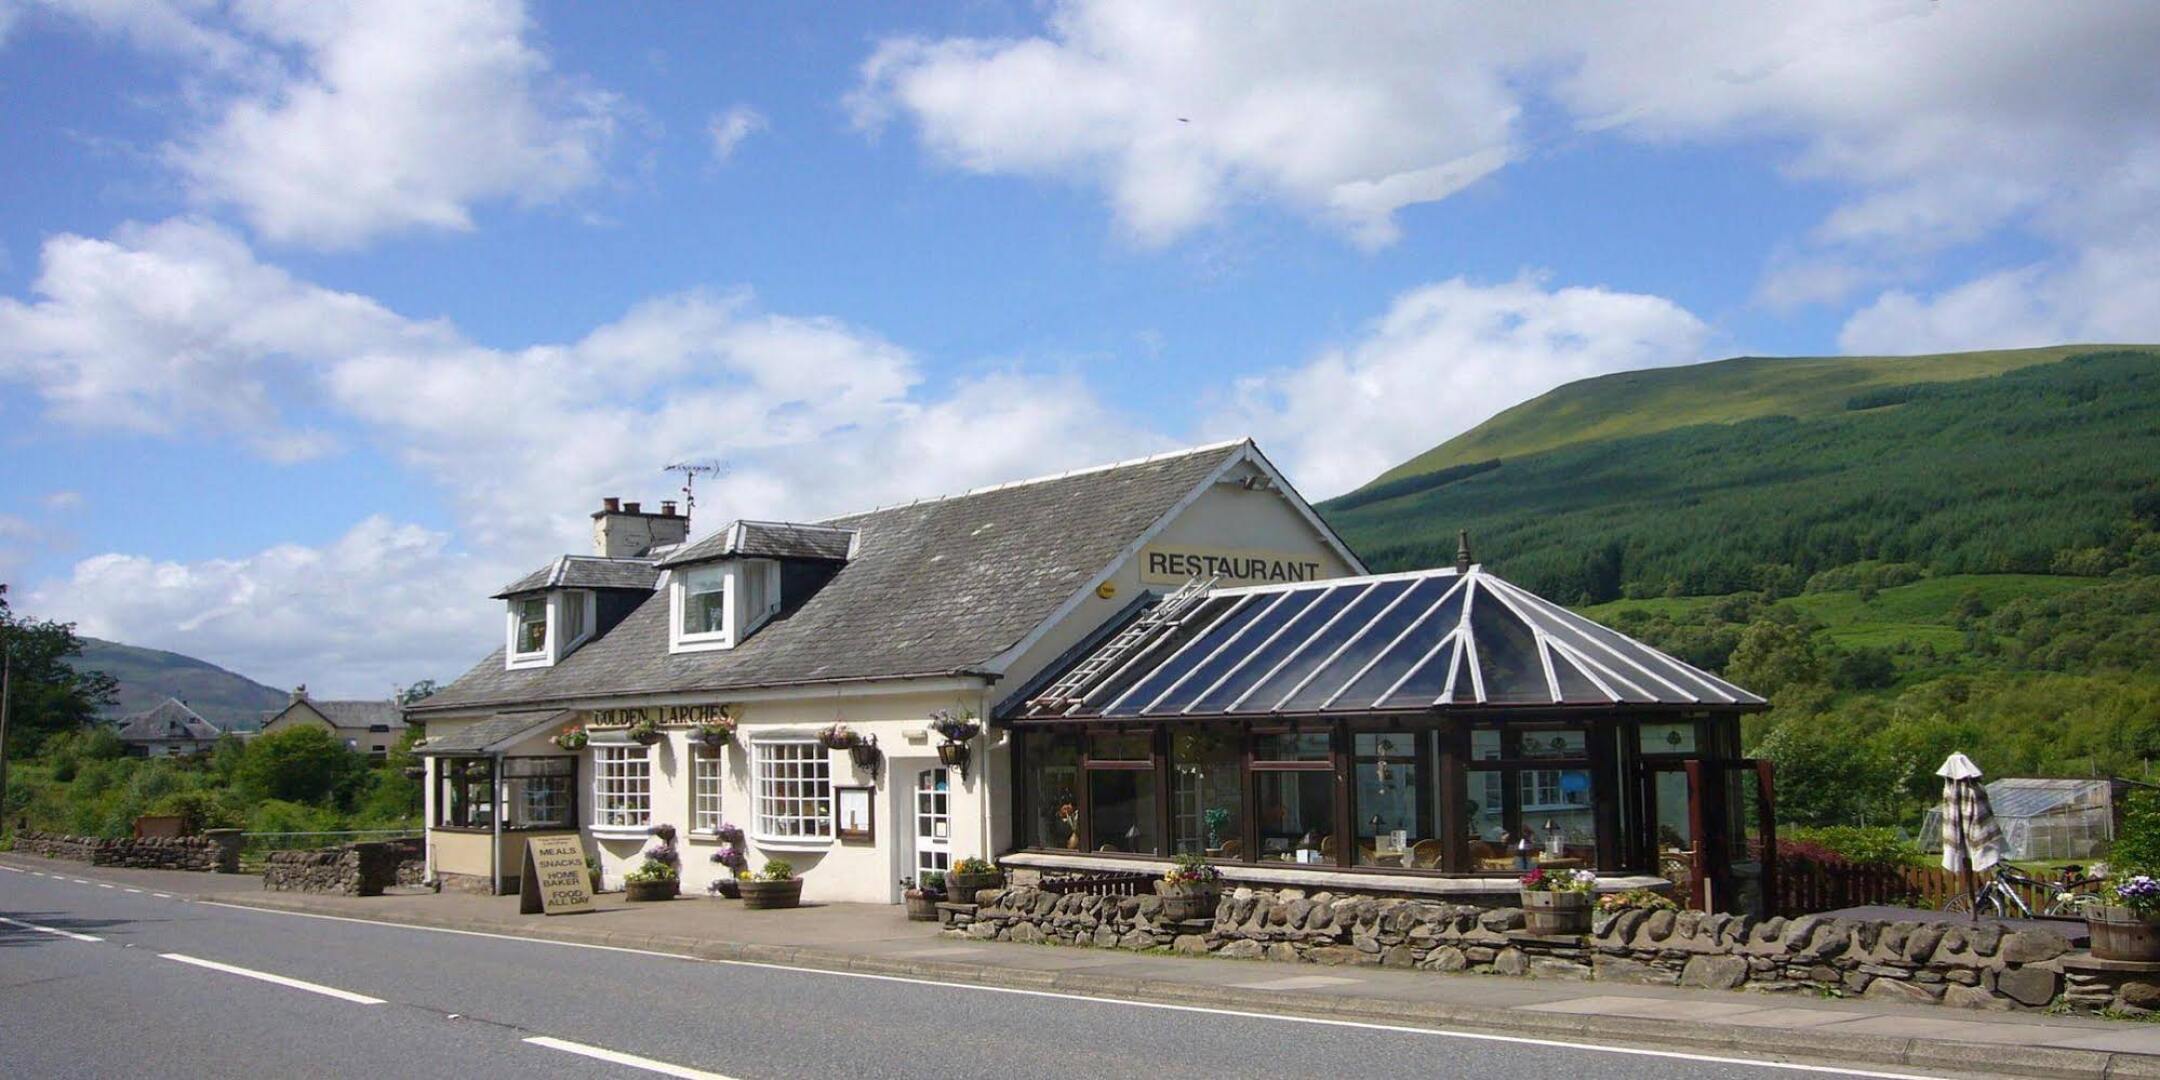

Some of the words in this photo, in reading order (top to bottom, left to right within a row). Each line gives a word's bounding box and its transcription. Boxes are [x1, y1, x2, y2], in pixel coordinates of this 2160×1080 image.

[1149, 552, 1320, 581] RESTAURANT
[594, 707, 648, 726] GOLDEN
[659, 704, 729, 724] LARCHES
[540, 859, 582, 867] SNACKS
[548, 871, 577, 879] HOME
[552, 890, 583, 898] FOOD
[571, 896, 589, 904] DAY
